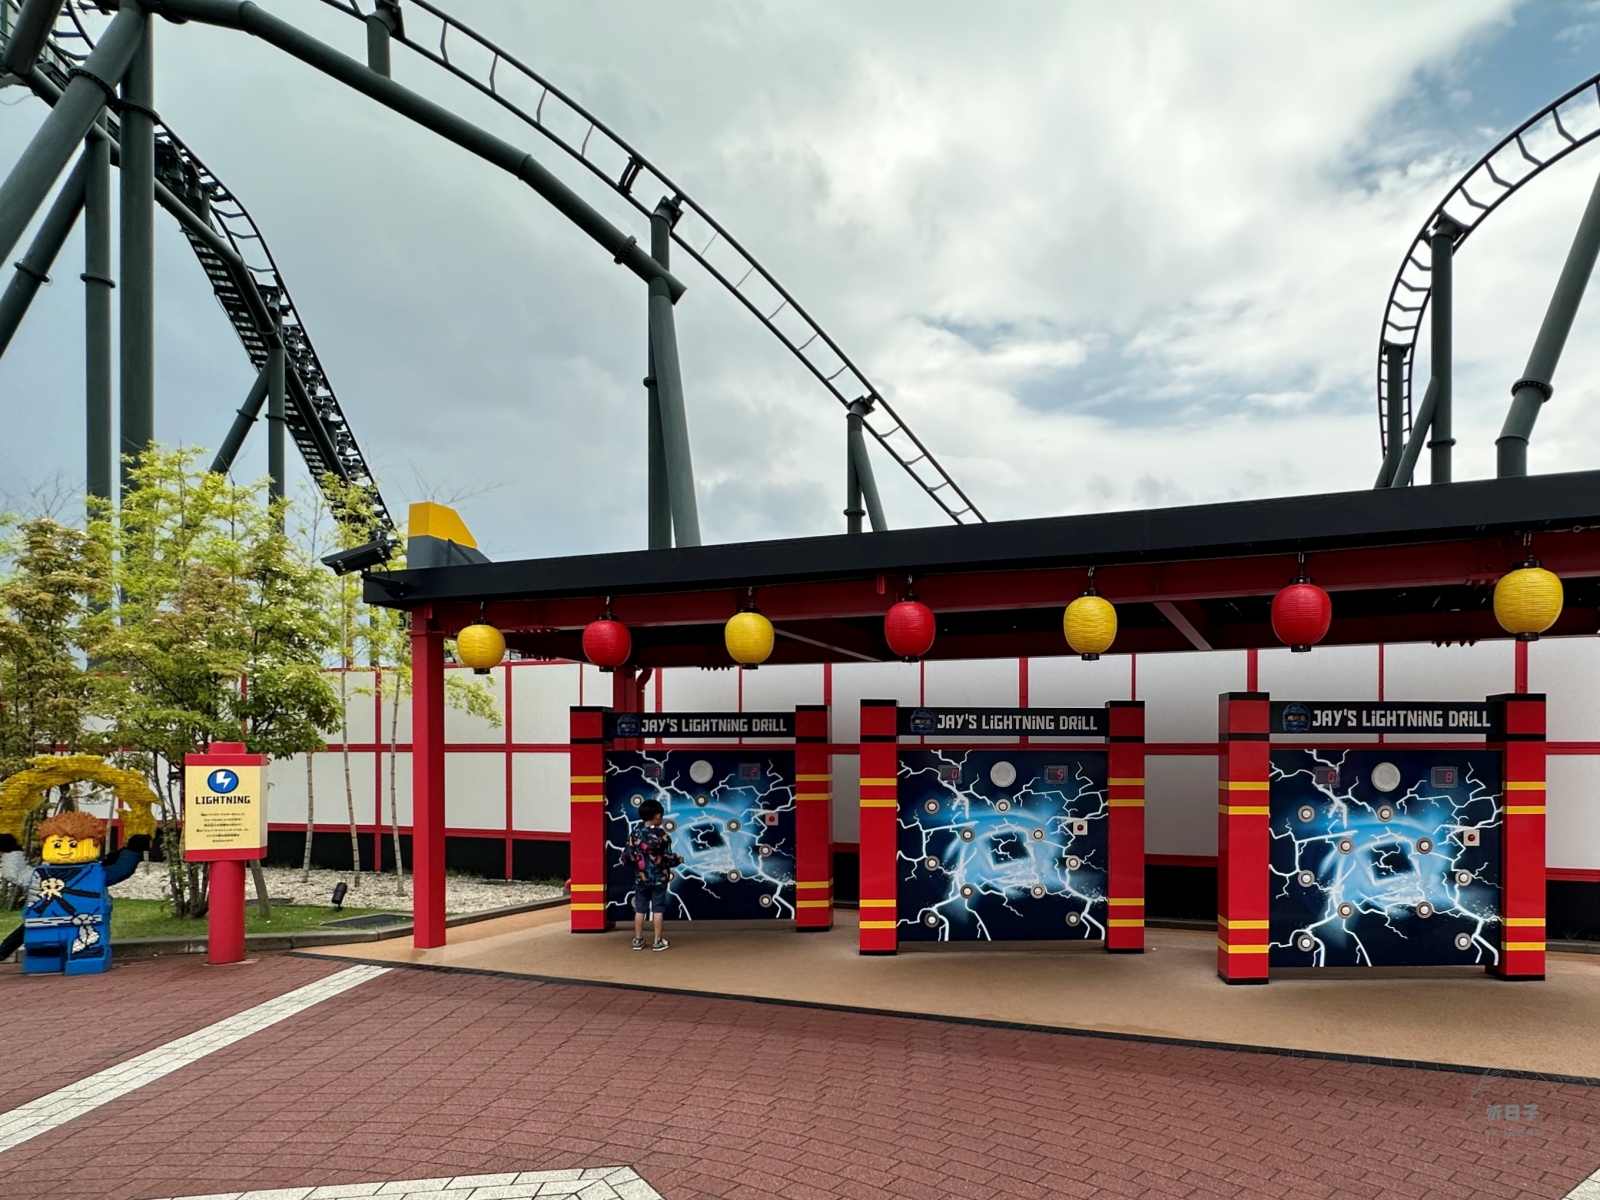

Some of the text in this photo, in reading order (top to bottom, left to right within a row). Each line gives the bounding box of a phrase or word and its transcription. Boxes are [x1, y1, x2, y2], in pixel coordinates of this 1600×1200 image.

[937, 714, 977, 729] JAY'S
[1312, 708, 1357, 727] JAY'S
[641, 718, 678, 732] JAY'S
[195, 795, 251, 805] LIGHTNING
